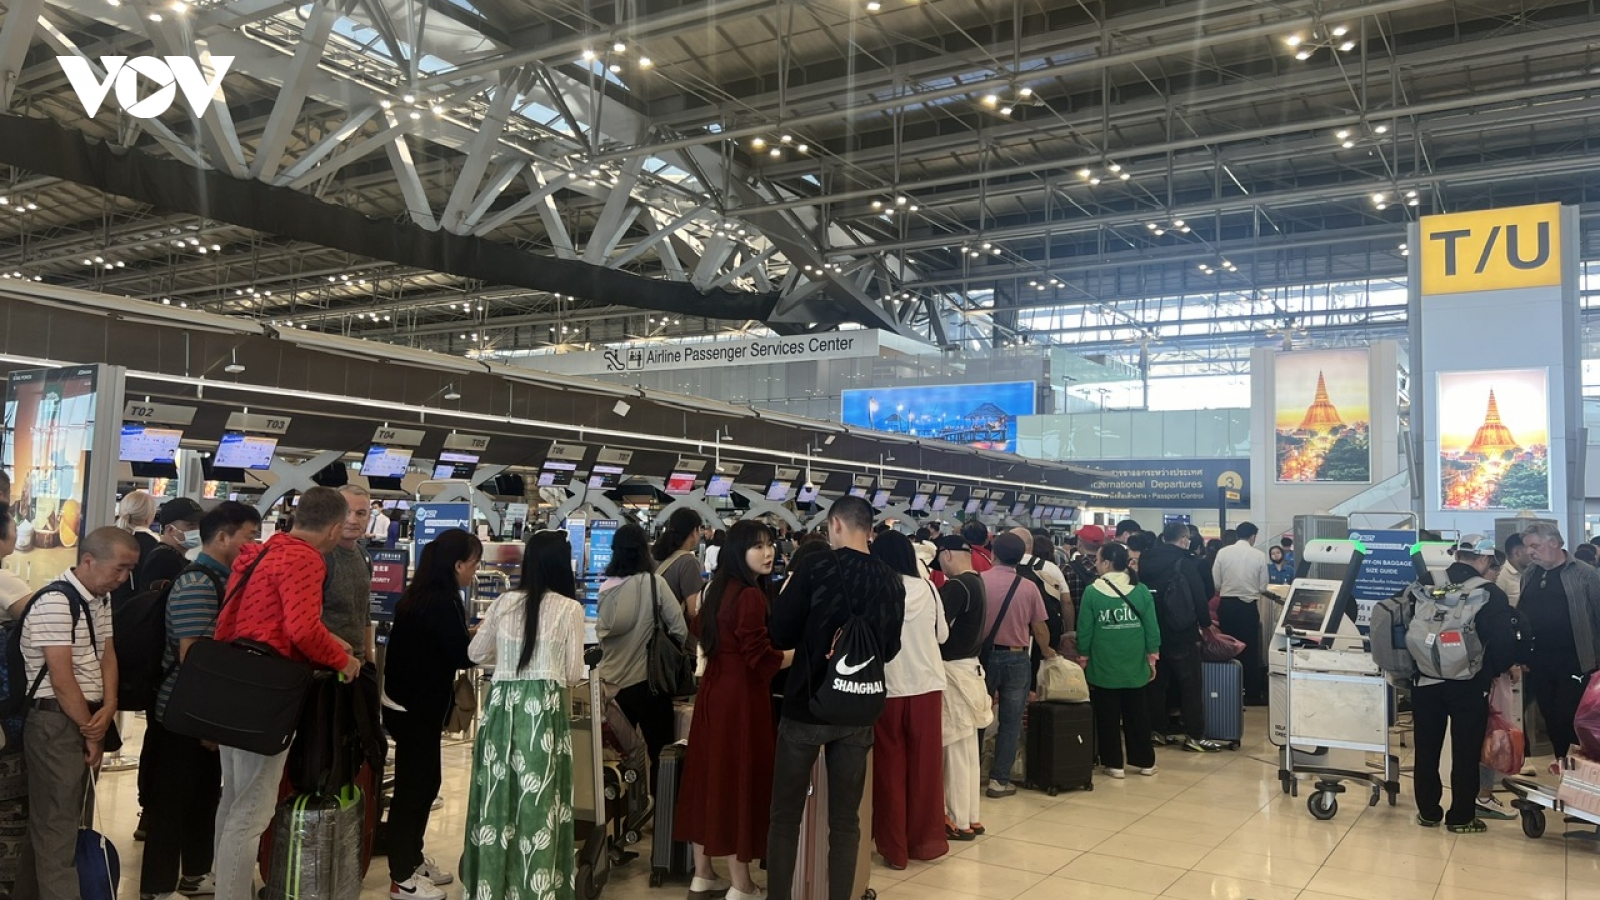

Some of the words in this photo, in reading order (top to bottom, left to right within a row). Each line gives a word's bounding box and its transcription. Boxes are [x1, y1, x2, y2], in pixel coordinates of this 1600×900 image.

[1430, 221, 1550, 276] T/U
[646, 349, 681, 364] Airline
[684, 346, 747, 362] Passenger
[750, 341, 804, 357] Services
[808, 337, 854, 352] Center
[131, 406, 154, 417] T02
[266, 419, 285, 430] T03
[379, 430, 395, 440] T04
[1151, 480, 1203, 490] Departures
[1225, 476, 1235, 489] 3
[1152, 492, 1180, 500] Passport
[1098, 608, 1138, 622] MGIC
[832, 677, 884, 694] SHANGHAI
